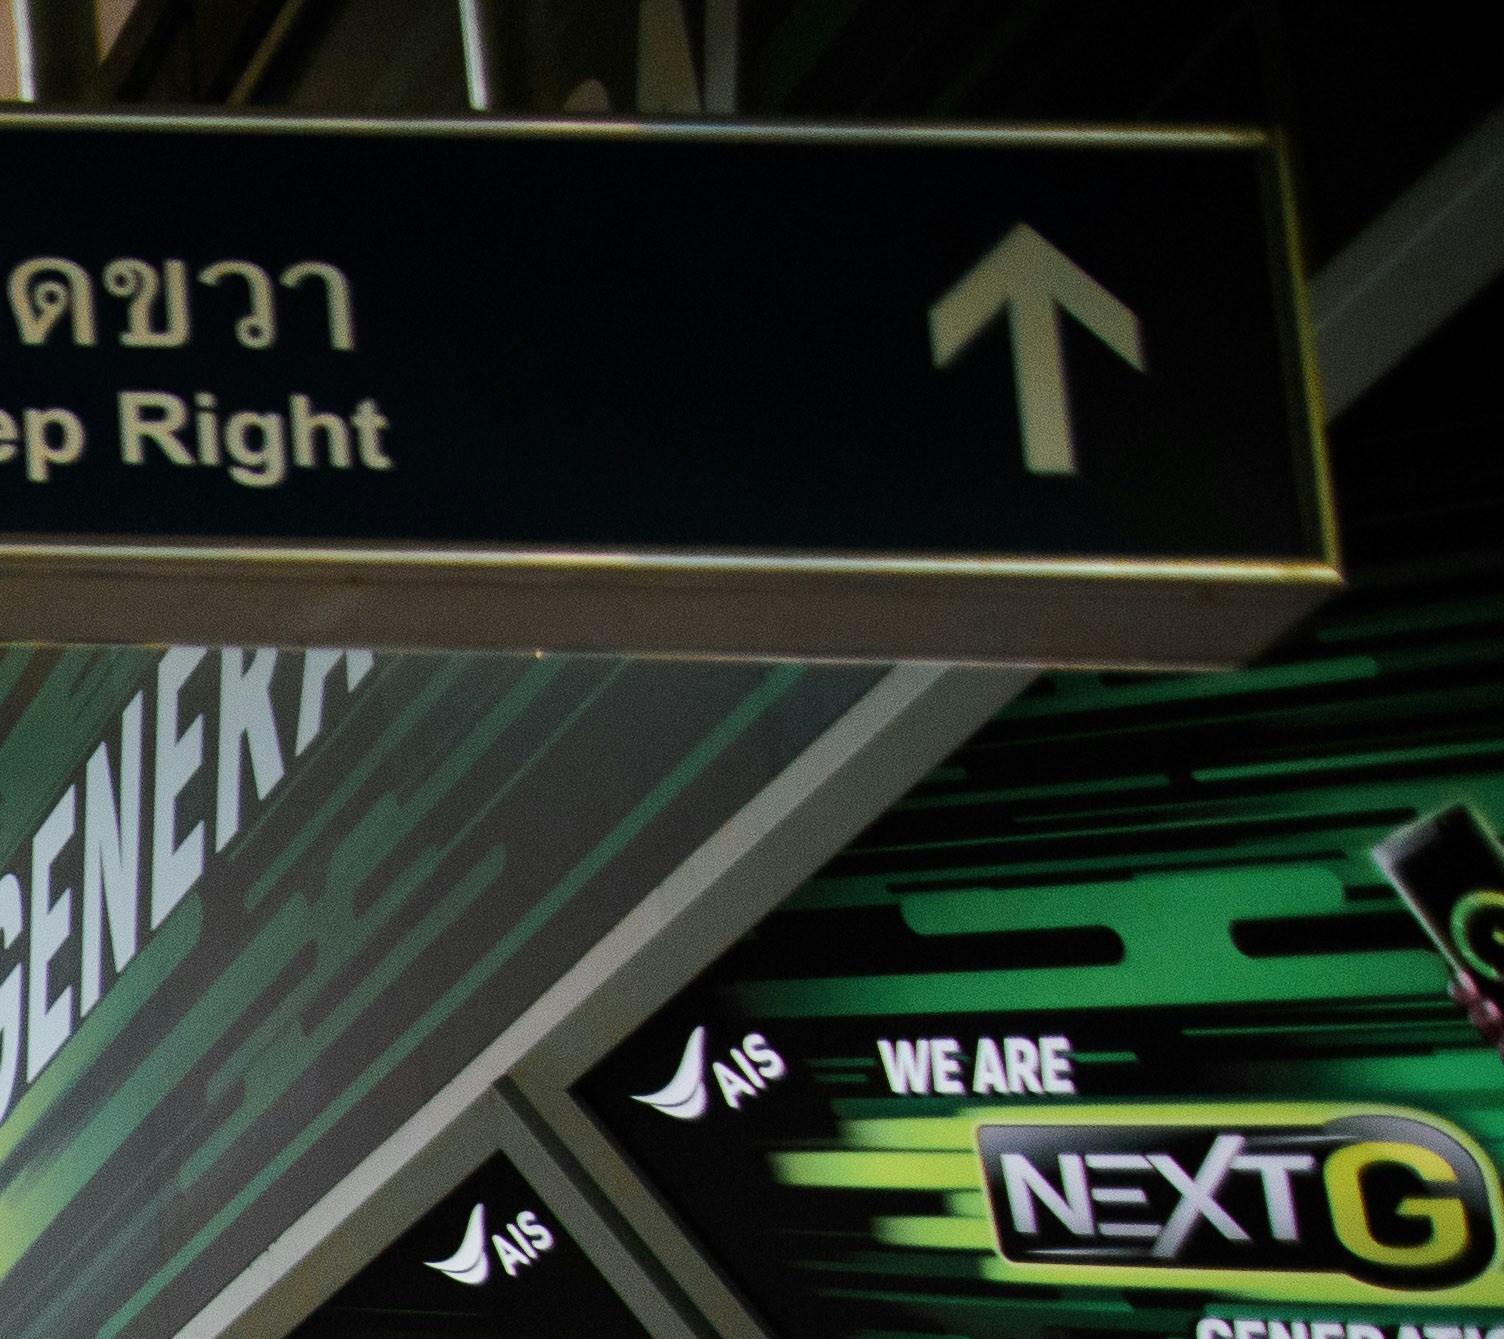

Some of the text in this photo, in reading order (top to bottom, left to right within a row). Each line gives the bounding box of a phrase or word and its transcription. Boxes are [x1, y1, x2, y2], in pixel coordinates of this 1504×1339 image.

[118, 391, 395, 488] Right
[711, 1033, 788, 1111] AIS
[878, 1036, 1075, 1096] WE ARE
[492, 1210, 555, 1278] AIS
